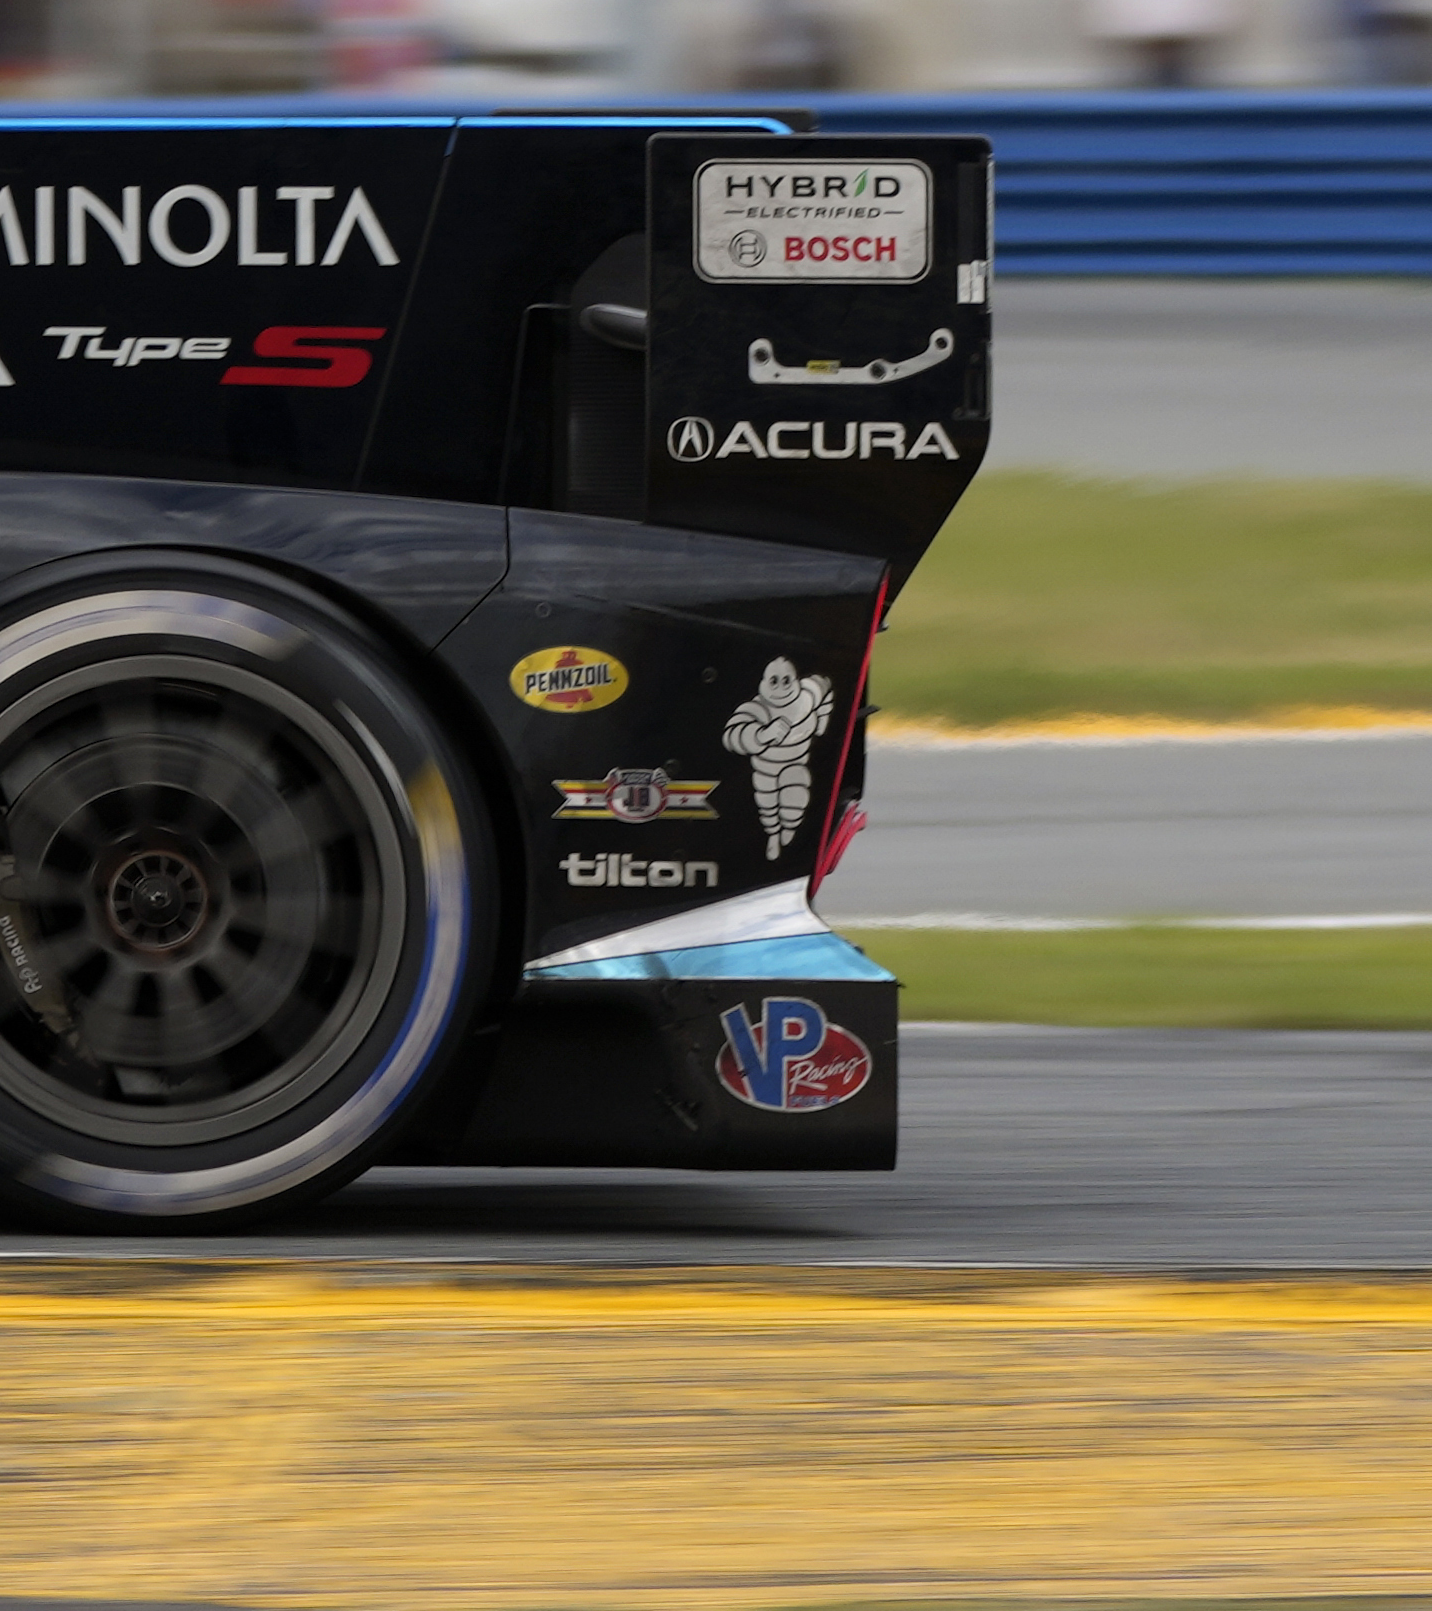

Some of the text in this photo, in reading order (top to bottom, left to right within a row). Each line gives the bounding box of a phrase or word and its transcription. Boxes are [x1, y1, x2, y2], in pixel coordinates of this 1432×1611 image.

[725, 172, 901, 198] HYBRID
[745, 206, 882, 219] ELECTRIFIED
[783, 236, 897, 262] BOSCH
[42, 325, 232, 367] Type
[219, 326, 388, 388] S
[715, 420, 960, 460] ACURA
[525, 663, 612, 694] PENNZOIL
[558, 852, 719, 888] tilton
[720, 996, 828, 1111] VP
[789, 1055, 868, 1095] Racing
